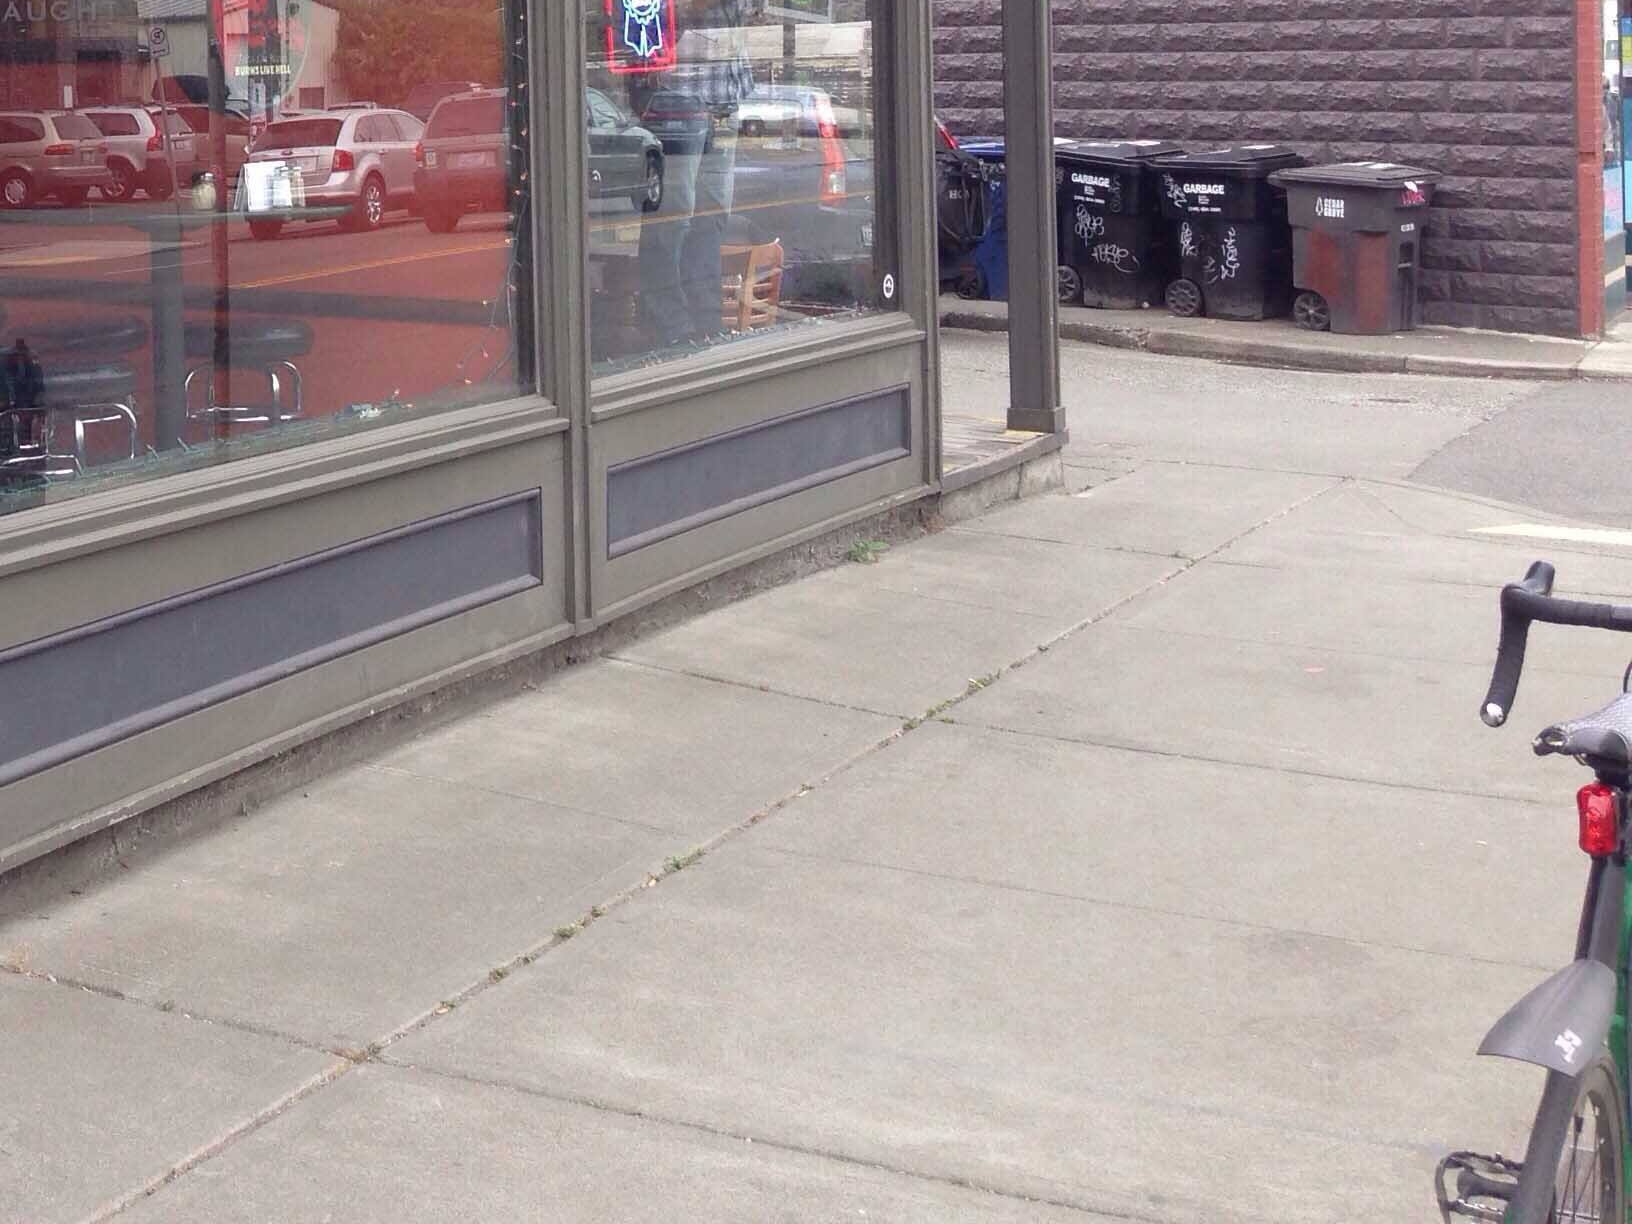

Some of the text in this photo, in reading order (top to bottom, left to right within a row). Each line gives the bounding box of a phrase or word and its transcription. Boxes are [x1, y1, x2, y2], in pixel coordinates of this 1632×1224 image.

[1071, 172, 1110, 188] GARBAGE
[1183, 183, 1225, 195] GARBAGE
[1323, 198, 1344, 208] CEDAR
